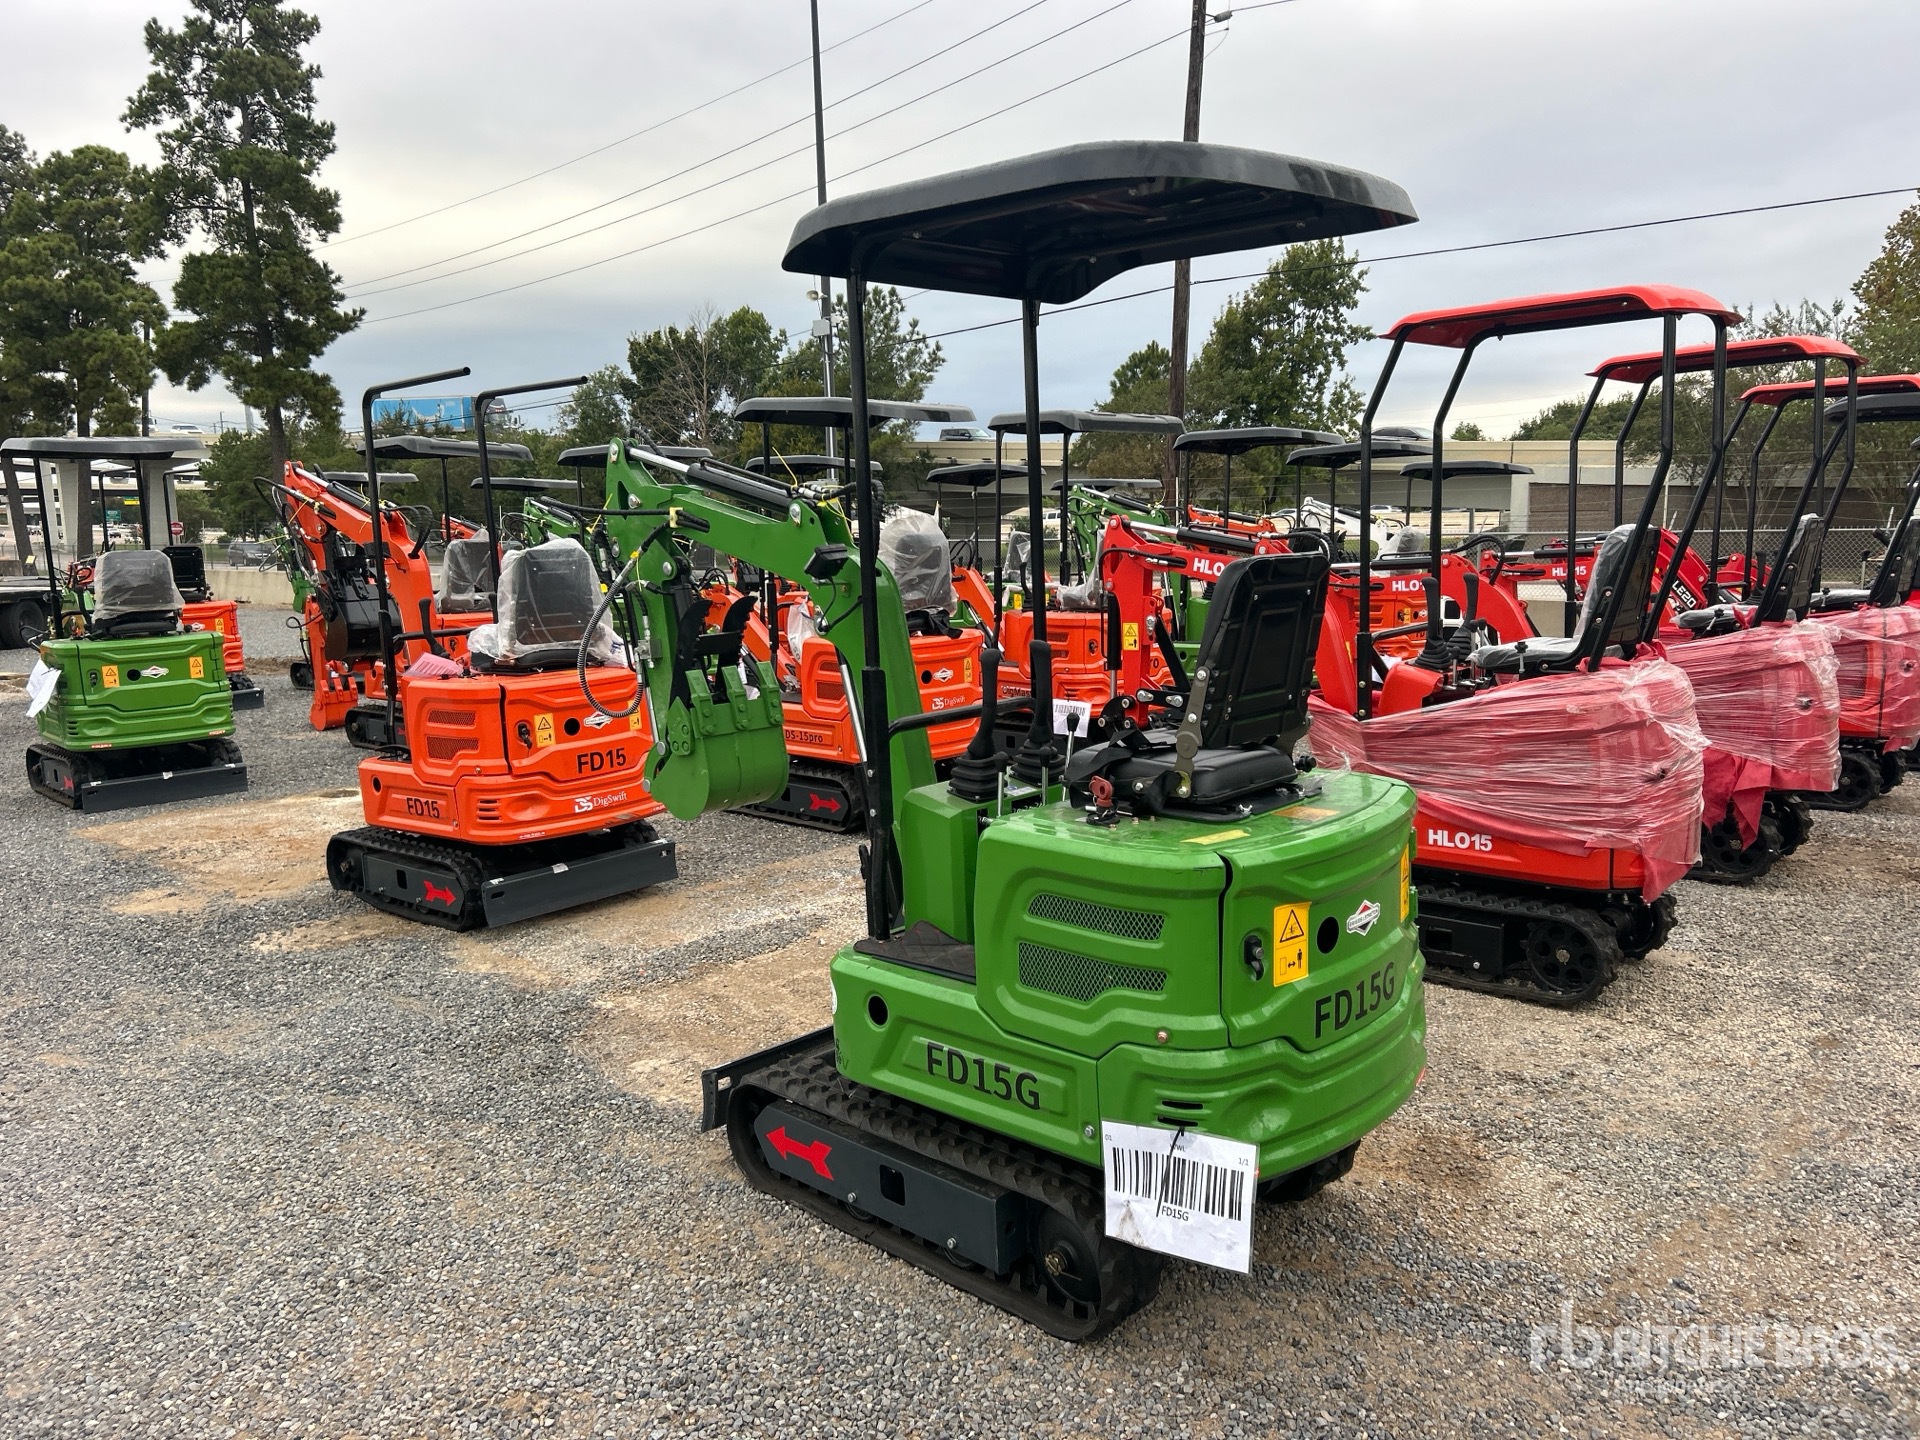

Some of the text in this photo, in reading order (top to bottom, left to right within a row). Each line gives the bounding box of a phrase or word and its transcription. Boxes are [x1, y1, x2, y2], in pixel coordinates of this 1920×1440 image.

[1193, 557, 1225, 577] HLO
[1551, 565, 1587, 577] HL15
[1671, 579, 1697, 609] LE20
[785, 729, 824, 744] DS-15pro
[577, 747, 627, 774] FD15
[406, 797, 441, 819] FD15
[593, 791, 628, 808] DigSwift
[1428, 829, 1493, 852] HLO15
[1314, 961, 1395, 1040] FD15G
[927, 1041, 1041, 1110] FD15G
[1161, 1205, 1190, 1222] FD15G
